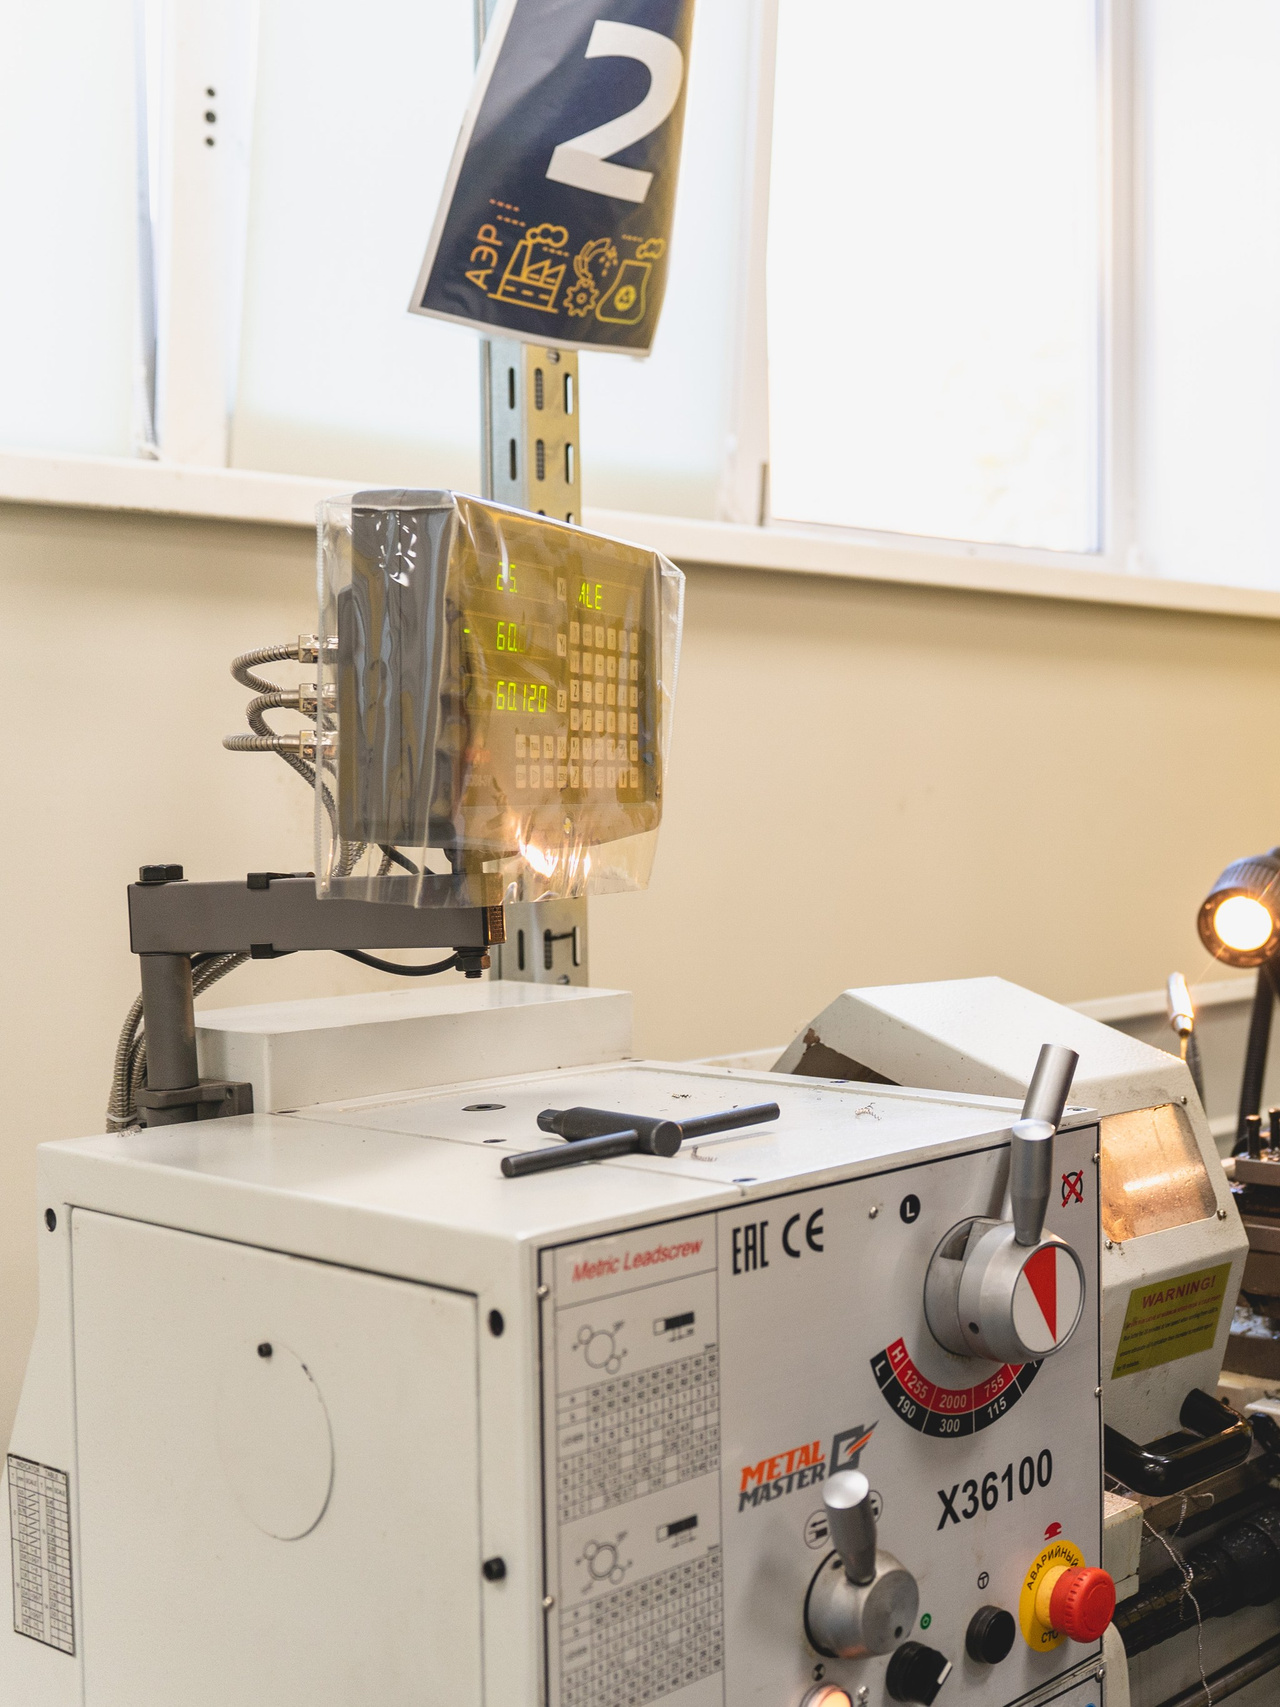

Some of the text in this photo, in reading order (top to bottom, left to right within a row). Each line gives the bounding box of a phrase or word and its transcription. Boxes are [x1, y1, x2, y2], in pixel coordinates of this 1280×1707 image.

[545, 19, 684, 204] 2
[465, 223, 503, 291] АЭР
[496, 681, 547, 713] 60.120
[732, 1207, 824, 1275] EAC CE
[571, 1239, 703, 1283] Metric Leadscrew
[1142, 1275, 1217, 1309] WARNING!
[904, 1369, 929, 1399] 1255
[984, 1374, 1004, 1397] 755
[897, 1395, 917, 1419] 190
[939, 1394, 967, 1409] 2000
[987, 1396, 1007, 1419] 115
[939, 1418, 960, 1433] 300
[740, 1440, 825, 1492] METAL
[738, 1462, 826, 1513] MASTER
[937, 1448, 1052, 1531] X36100
[1026, 1545, 1079, 1591] АВАРИЙНЫЙ
[1041, 1630, 1059, 1644] СТО
